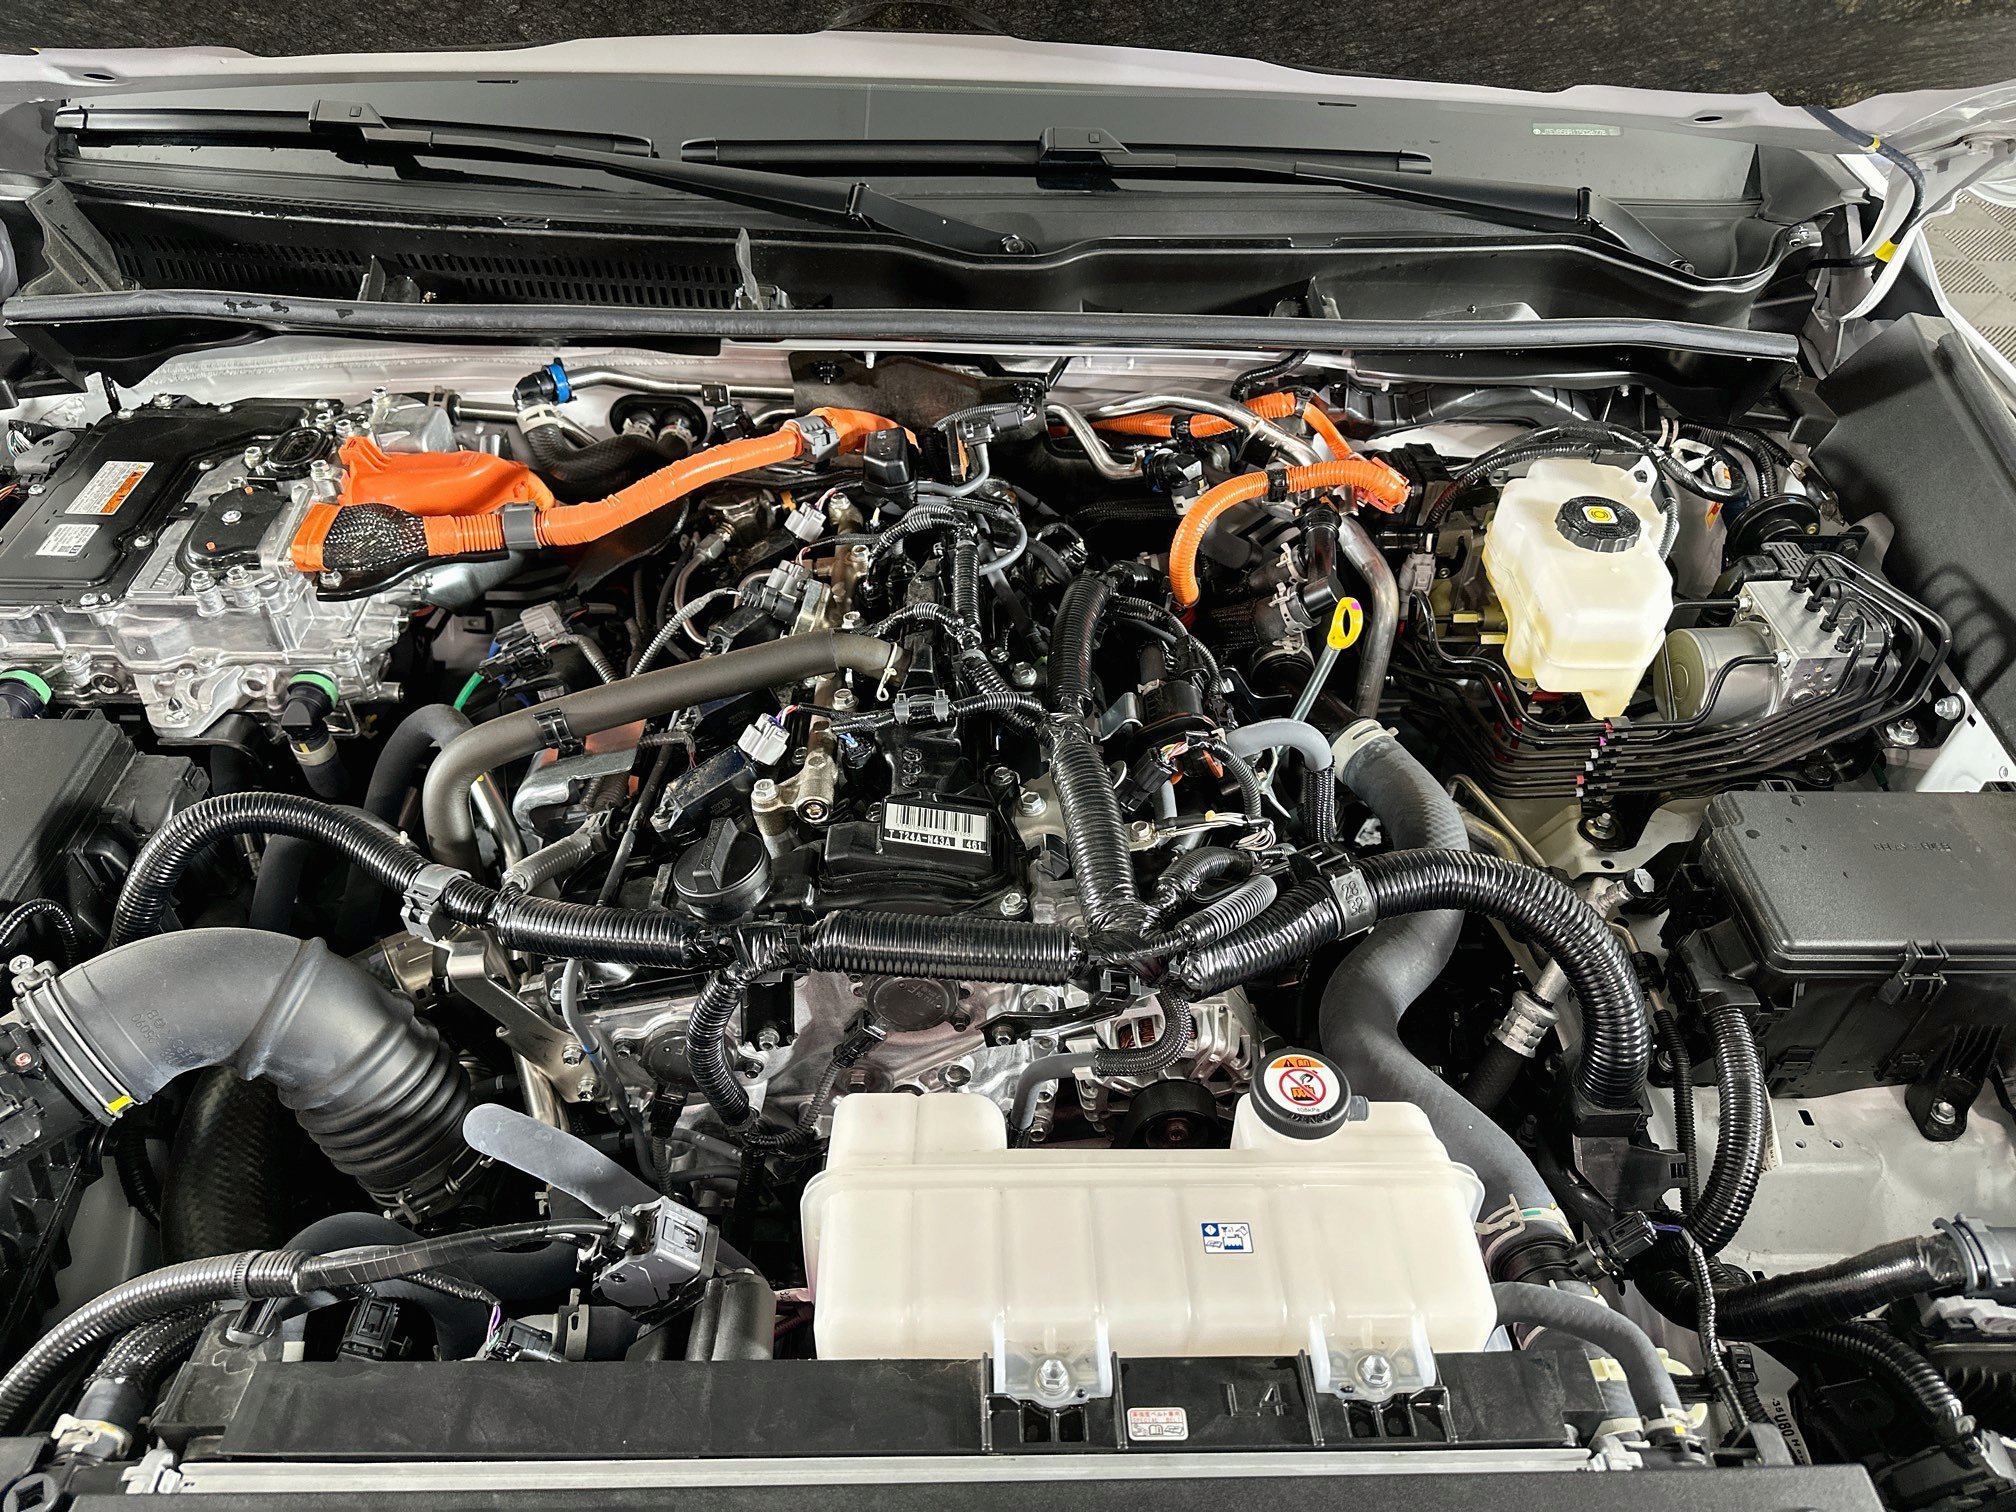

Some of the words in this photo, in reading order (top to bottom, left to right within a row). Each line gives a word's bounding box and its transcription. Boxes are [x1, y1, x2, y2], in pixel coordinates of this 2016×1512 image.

[888, 829, 896, 839] T
[899, 831, 952, 847] T24A-N43A
[965, 839, 983, 851] 461
[1341, 880, 1359, 900] 28
[1347, 896, 1367, 917] 32
